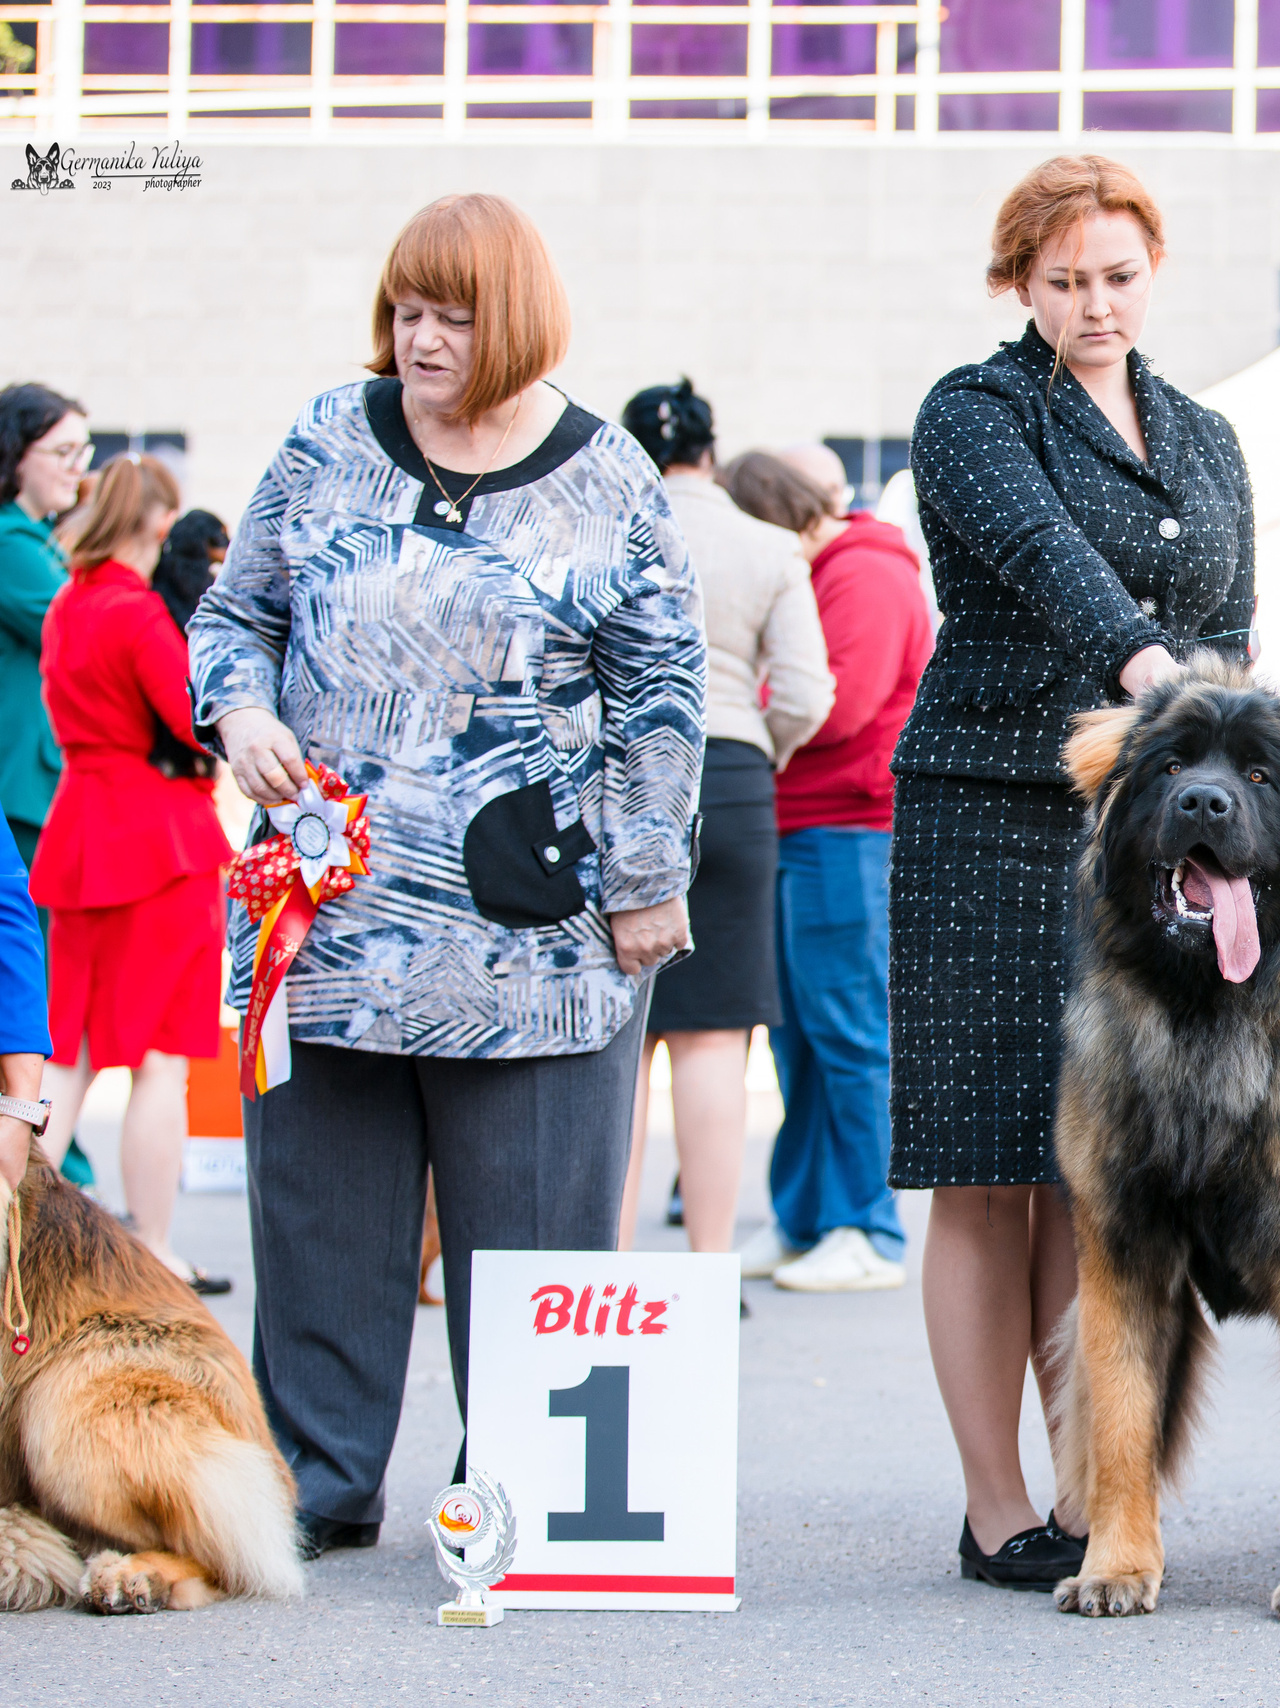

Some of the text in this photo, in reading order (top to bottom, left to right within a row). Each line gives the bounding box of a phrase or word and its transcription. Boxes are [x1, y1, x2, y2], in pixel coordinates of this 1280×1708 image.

[244, 946, 289, 1056] WINNER
[529, 1281, 670, 1338] Blitz
[547, 1364, 665, 1542] 1
